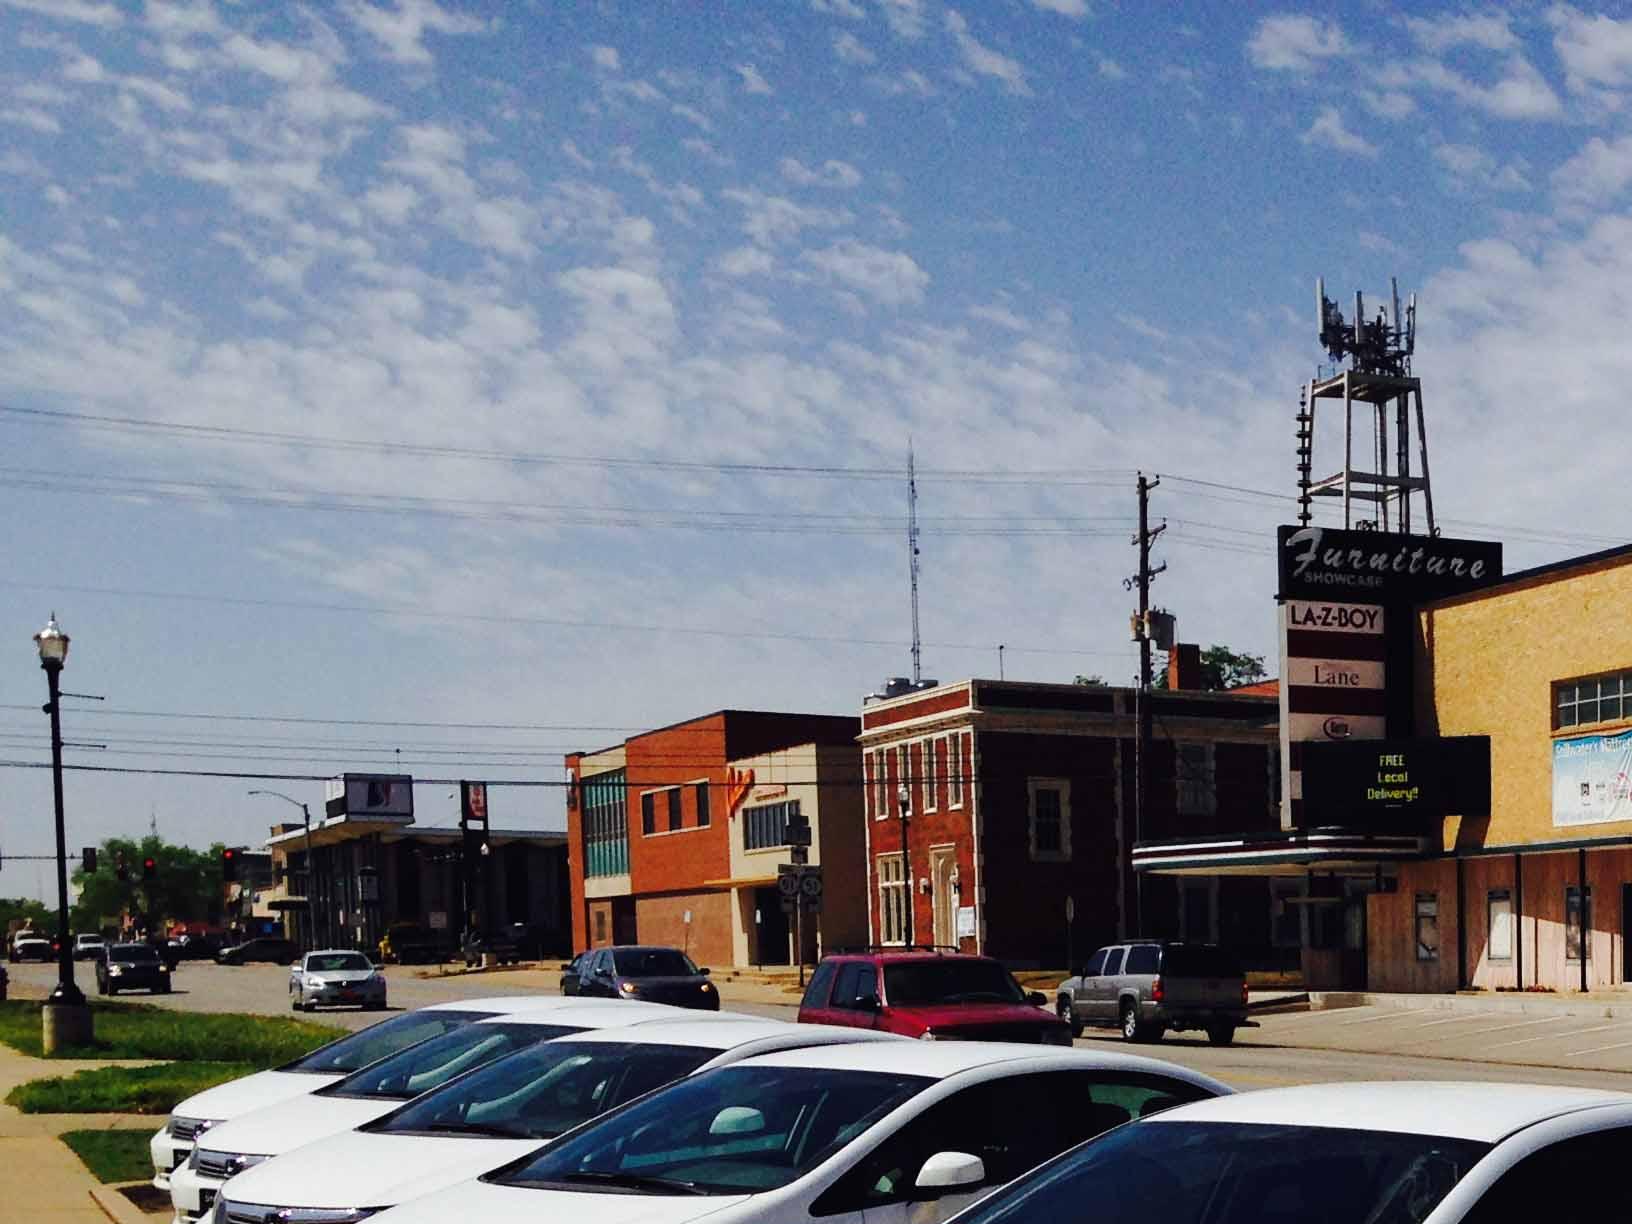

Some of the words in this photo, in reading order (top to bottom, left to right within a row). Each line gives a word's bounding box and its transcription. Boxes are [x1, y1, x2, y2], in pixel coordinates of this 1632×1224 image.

[1286, 527, 1486, 579] Furniture
[1304, 571, 1384, 587] SHOWCASE
[1291, 604, 1379, 629] LA-Z-BOY
[1314, 664, 1360, 686] Lane
[1379, 754, 1405, 766] FREE
[1378, 771, 1408, 783] Local
